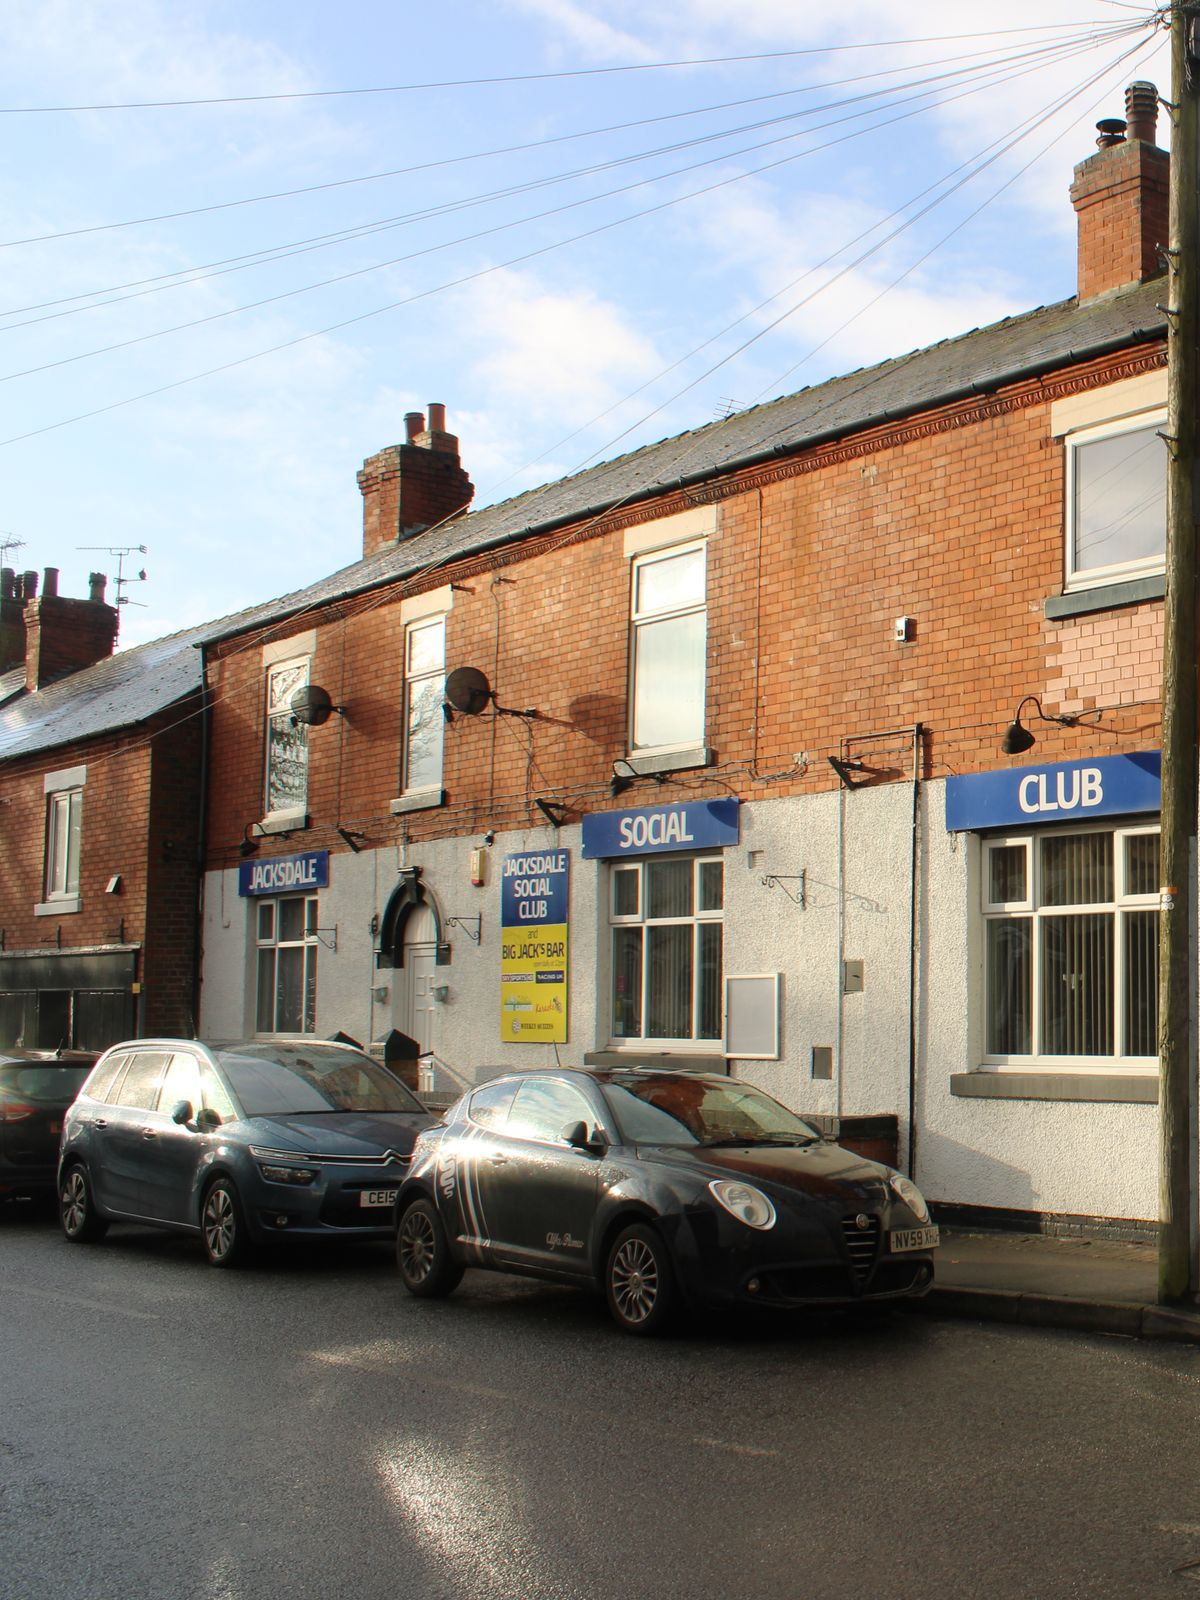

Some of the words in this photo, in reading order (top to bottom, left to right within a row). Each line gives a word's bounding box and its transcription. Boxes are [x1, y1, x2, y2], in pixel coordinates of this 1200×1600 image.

[1018, 767, 1104, 814] CLUB
[619, 810, 694, 848] SOCIAL
[248, 858, 317, 890] JACKSDALE
[504, 854, 566, 877] JACKSDALE
[514, 878, 553, 898] SOCIAL
[519, 900, 547, 919] CLUB
[527, 928, 539, 940] and
[502, 944, 516, 960] BIG
[517, 943, 546, 960] JACK'S
[546, 942, 565, 959] BAR
[369, 1191, 396, 1204] CE15
[896, 1230, 923, 1248] NV59
